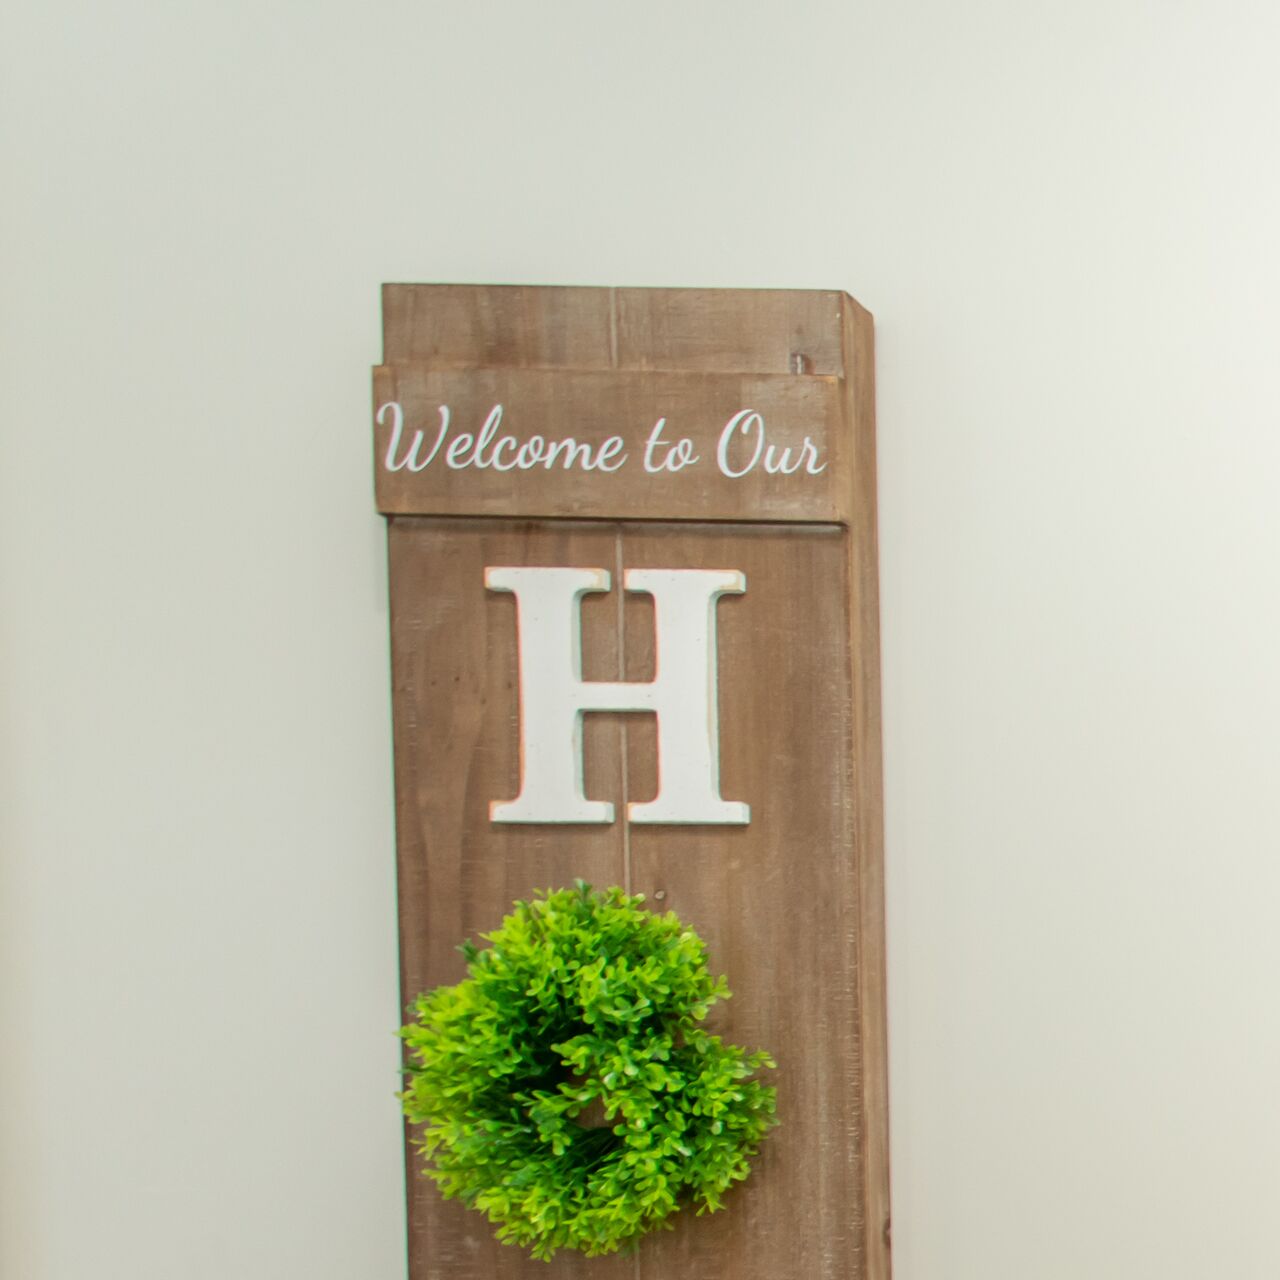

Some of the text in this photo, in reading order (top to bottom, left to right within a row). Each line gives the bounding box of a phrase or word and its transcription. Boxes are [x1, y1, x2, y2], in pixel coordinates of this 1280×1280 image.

[376, 401, 828, 478] Welcome to Our
